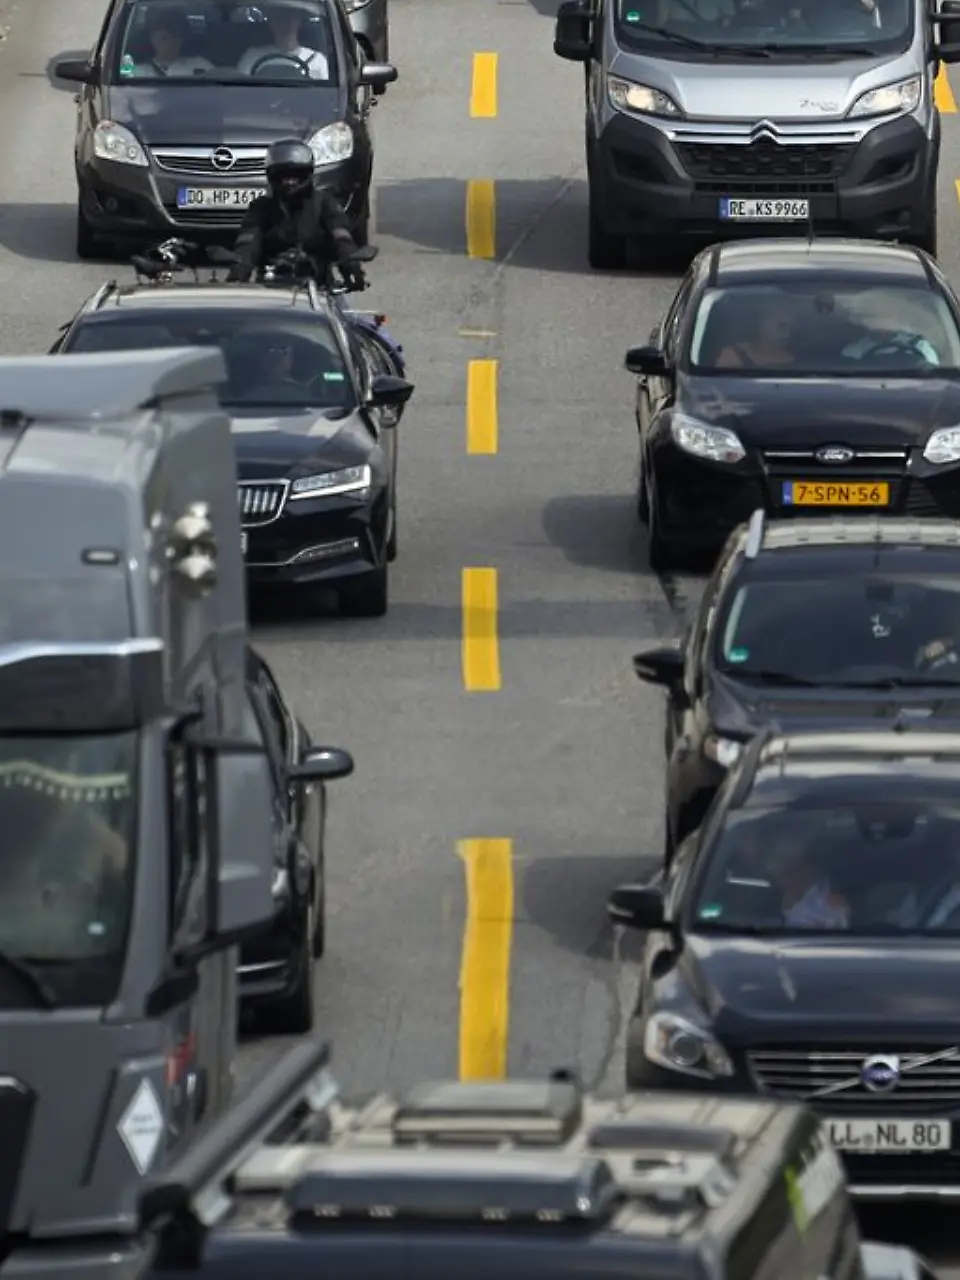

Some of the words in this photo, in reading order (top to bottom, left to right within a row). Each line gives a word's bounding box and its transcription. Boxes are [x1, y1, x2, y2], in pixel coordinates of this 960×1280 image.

[213, 190, 229, 204] HP
[730, 201, 746, 215] RE
[756, 202, 772, 215] KS
[775, 202, 807, 215] 9966
[876, 1122, 907, 1145] NL
[912, 1123, 941, 1146] 80
